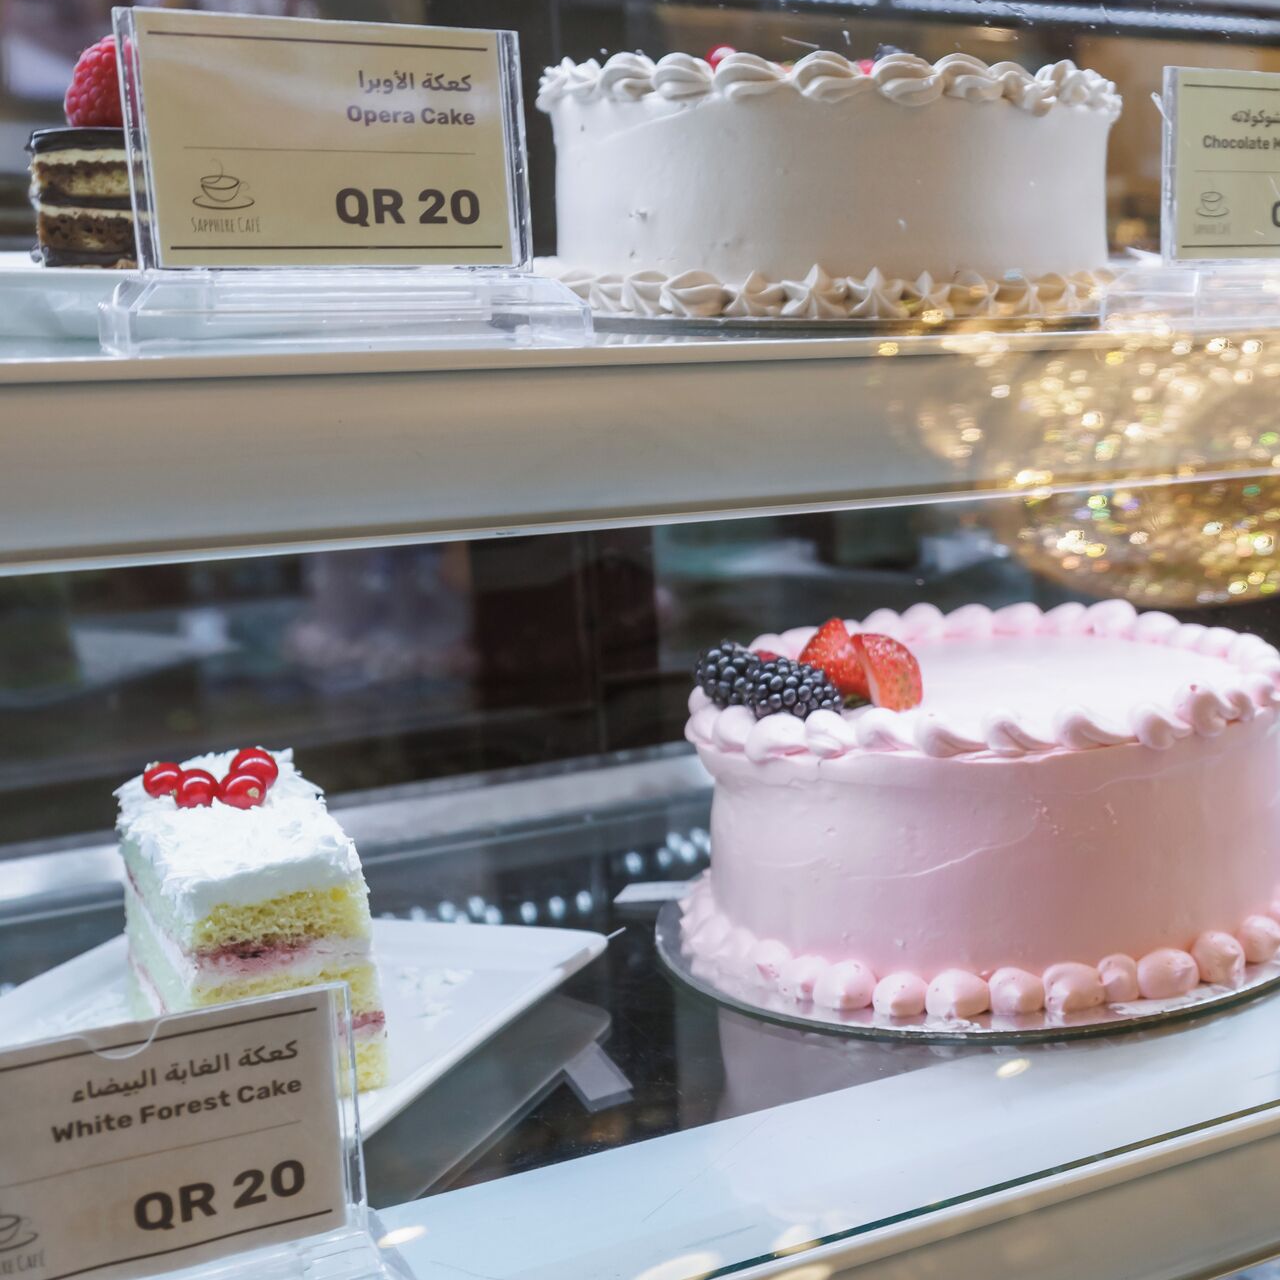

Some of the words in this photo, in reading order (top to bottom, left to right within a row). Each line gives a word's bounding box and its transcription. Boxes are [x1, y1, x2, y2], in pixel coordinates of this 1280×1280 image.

[358, 69, 415, 95] الأوبرا
[421, 73, 472, 93] كعكة
[346, 104, 415, 127] Opera
[421, 106, 476, 126] Cake
[1202, 135, 1270, 150] Chocolate
[335, 187, 405, 228] QR
[418, 188, 481, 226] 20
[164, 1052, 230, 1083] الغابة
[239, 1039, 299, 1068] كعكة
[71, 1068, 157, 1104] البيضاء
[51, 1112, 133, 1144] White
[140, 1088, 231, 1125] Forest
[237, 1077, 302, 1105] Cake
[134, 1182, 217, 1232] QR
[233, 1159, 306, 1210] 20
